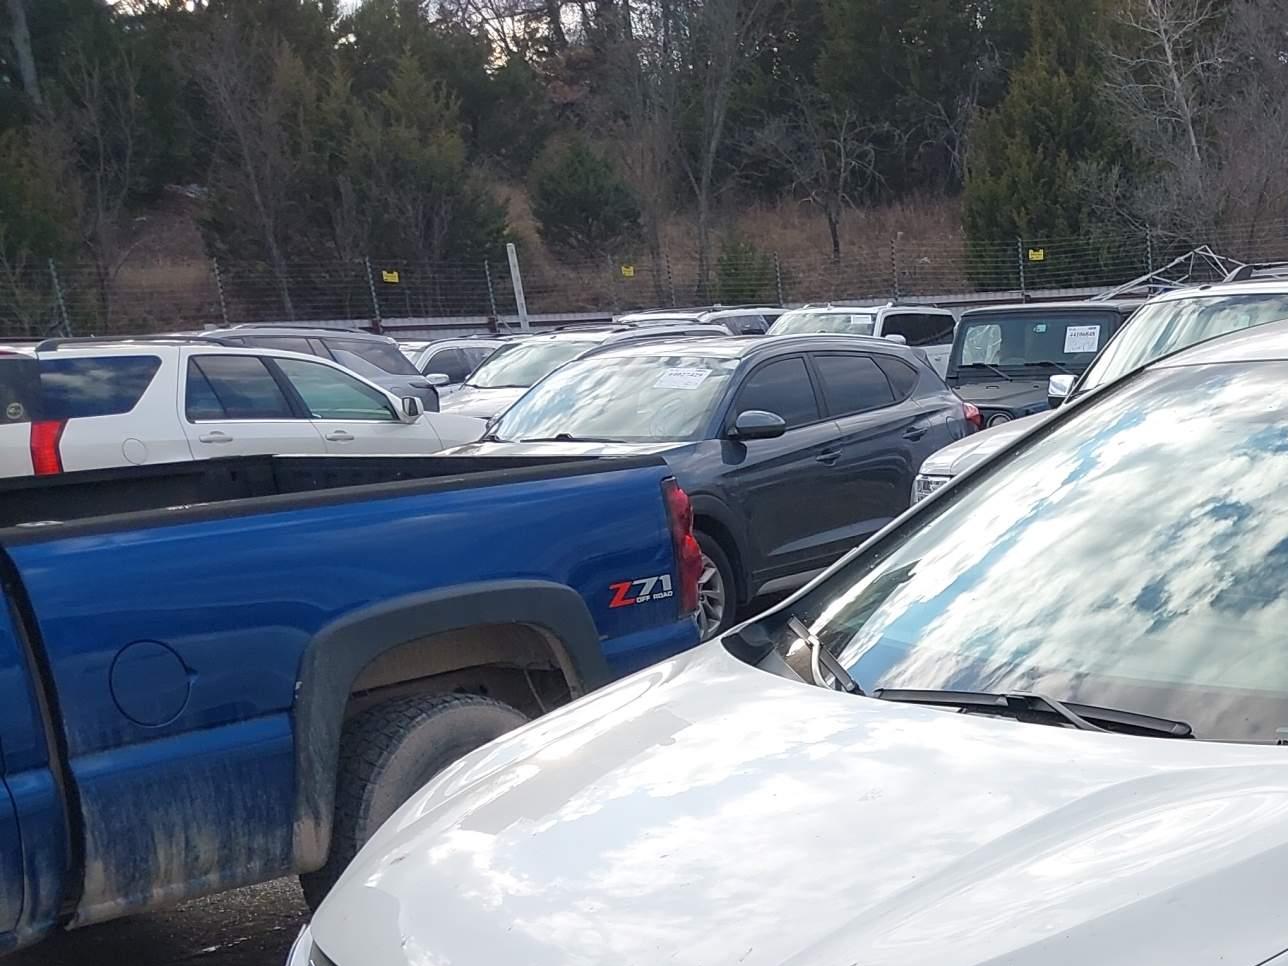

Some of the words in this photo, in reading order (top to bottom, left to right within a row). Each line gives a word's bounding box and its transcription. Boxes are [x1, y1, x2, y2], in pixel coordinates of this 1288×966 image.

[609, 574, 671, 607] Z71
[636, 595, 651, 603] OFF
[653, 591, 673, 599] ROAD
